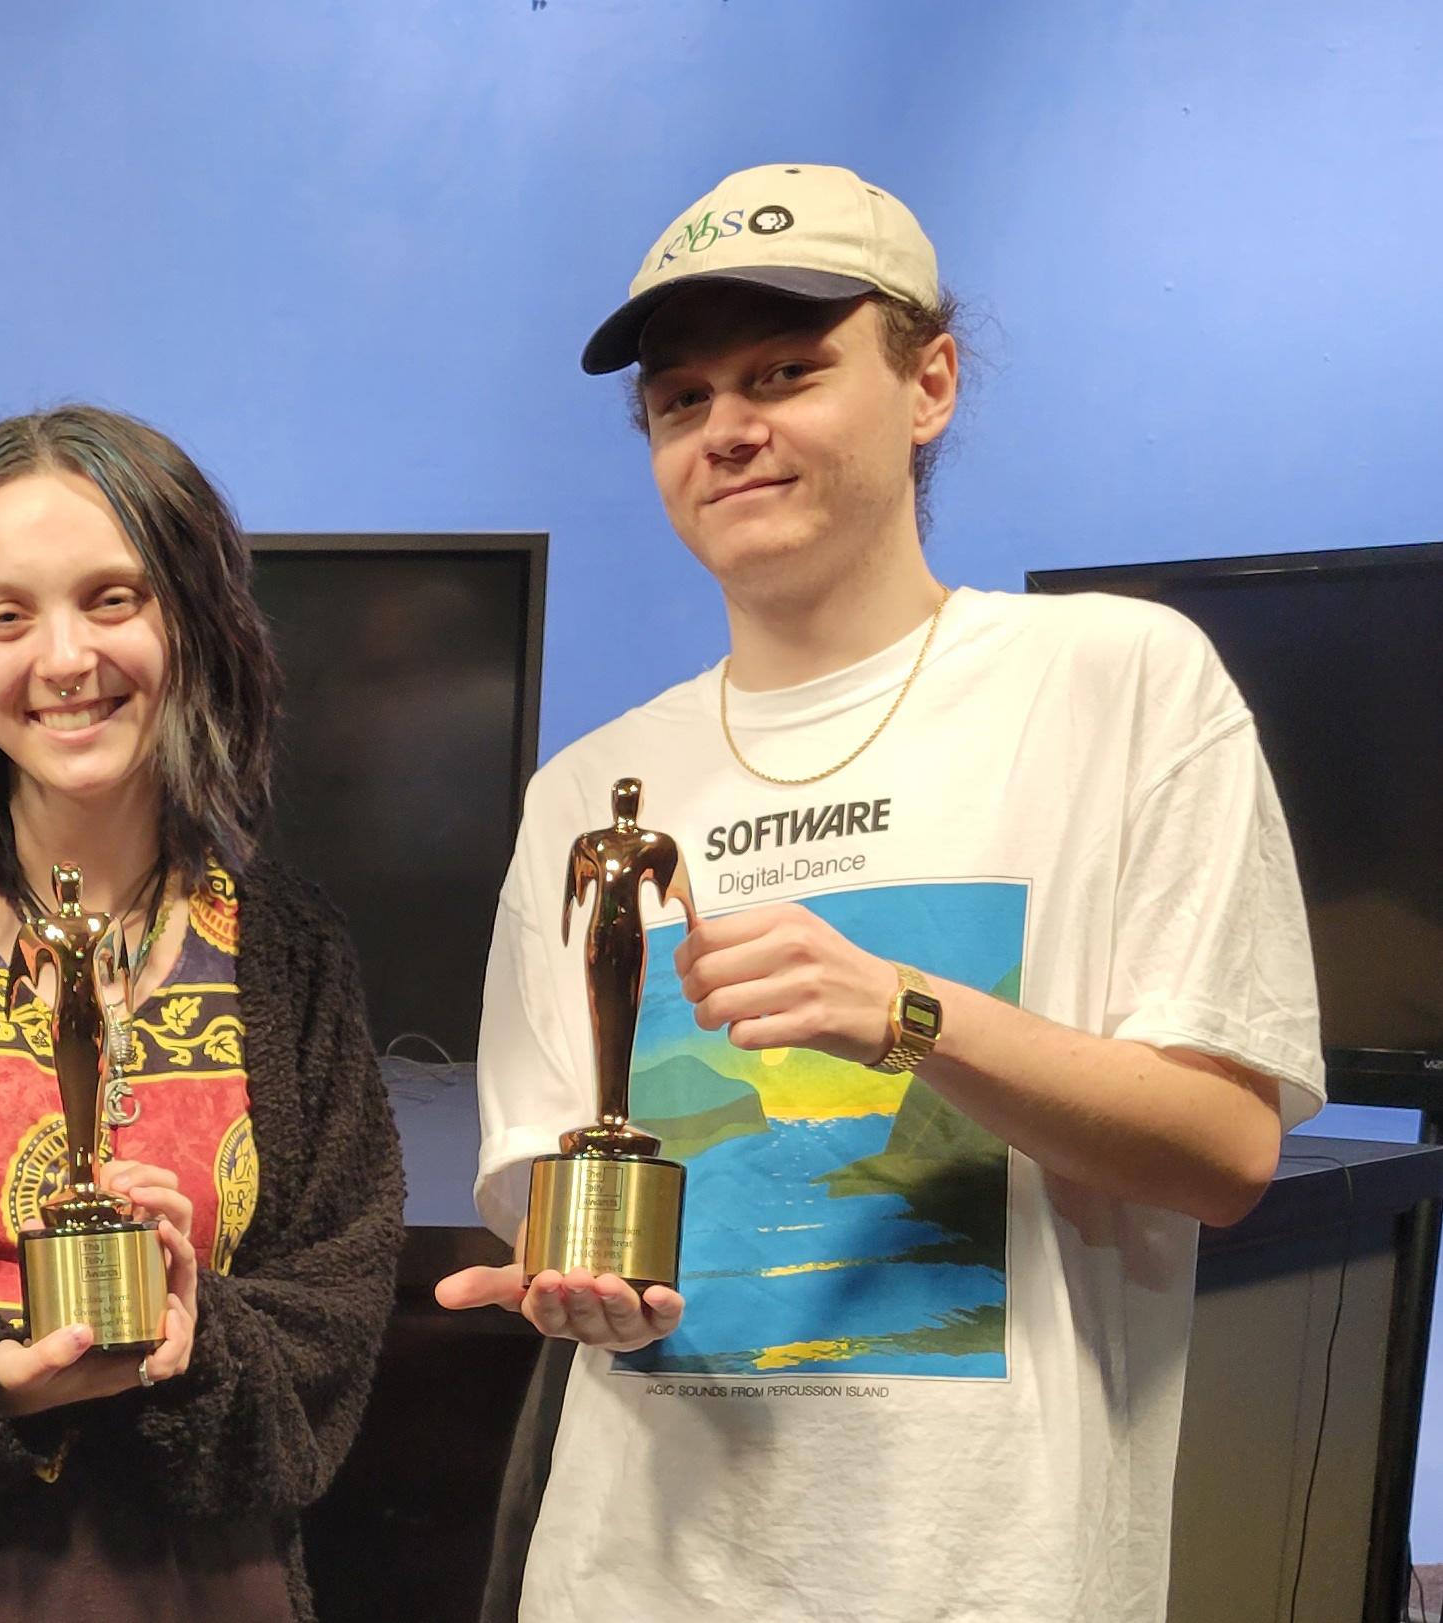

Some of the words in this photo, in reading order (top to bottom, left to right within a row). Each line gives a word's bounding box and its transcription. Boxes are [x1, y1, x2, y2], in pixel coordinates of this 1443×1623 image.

[654, 210, 745, 272] KMOS
[705, 797, 892, 862] SOFTWARE
[718, 853, 866, 895] Digital-Dance
[84, 1243, 100, 1252] The
[84, 1268, 119, 1279] Awards
[678, 1385, 727, 1398] SOUNDS
[731, 1386, 764, 1398] FROM
[767, 1386, 842, 1397] PERCUSSION
[845, 1386, 890, 1398] ISLAND
